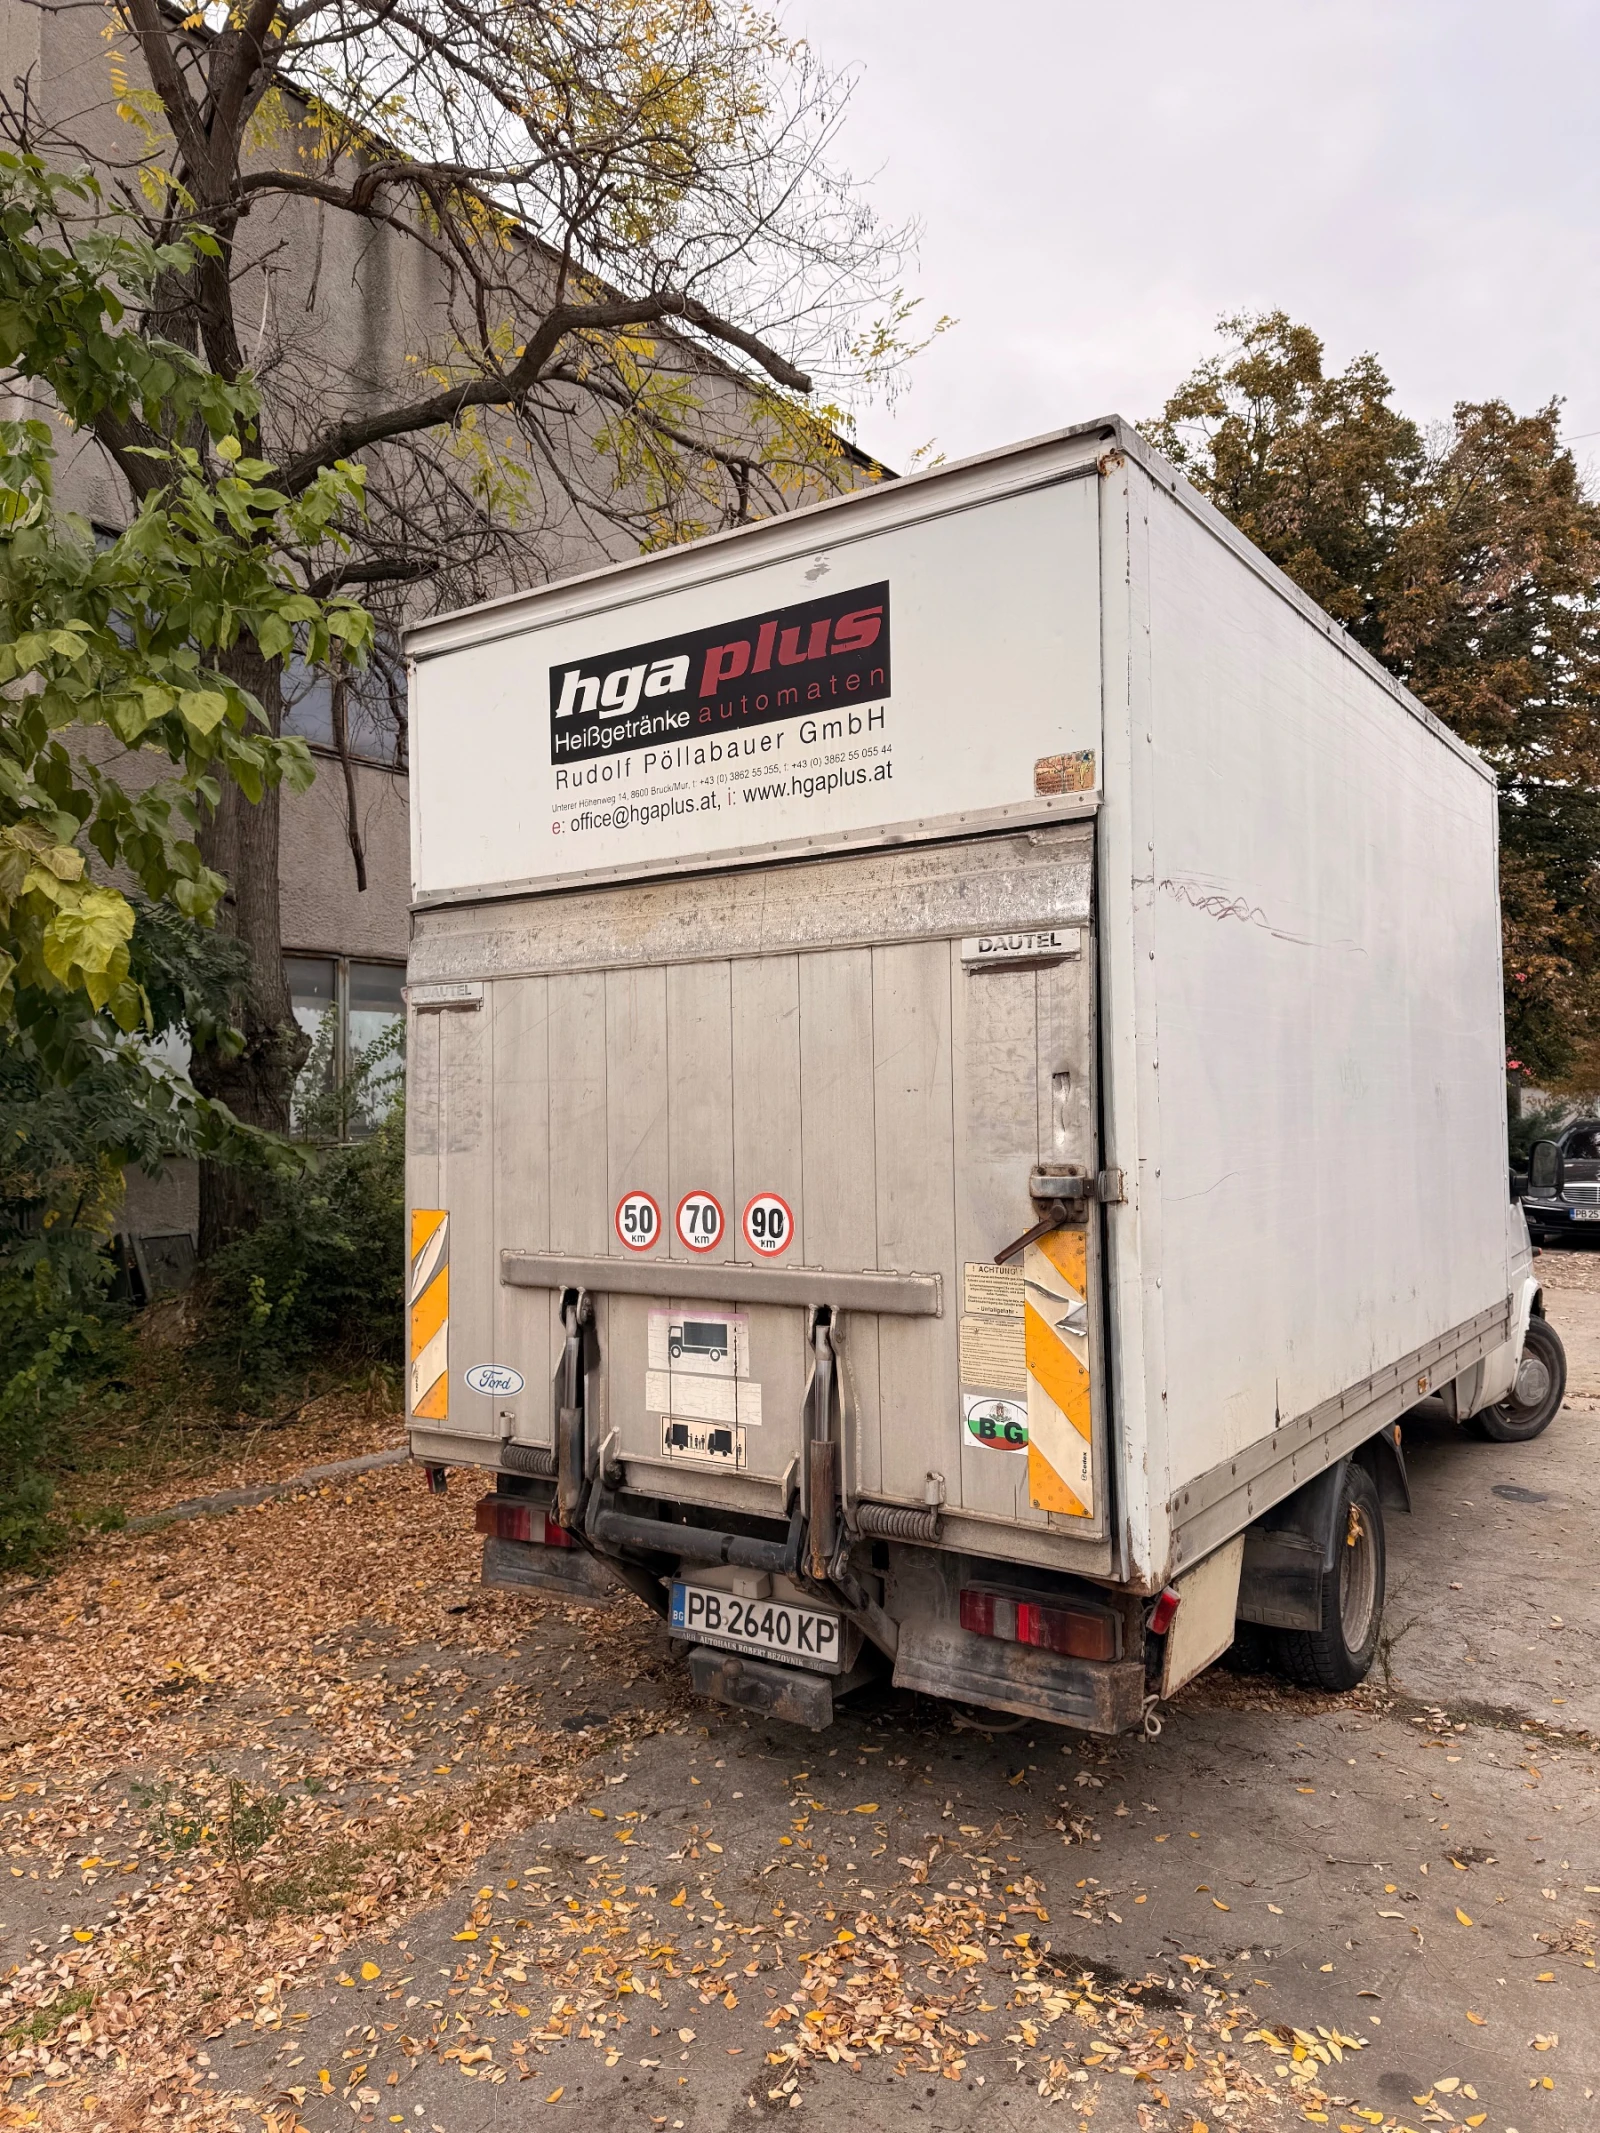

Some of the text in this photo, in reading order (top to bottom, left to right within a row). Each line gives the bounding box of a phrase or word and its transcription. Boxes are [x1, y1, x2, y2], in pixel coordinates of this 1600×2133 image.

[555, 605, 883, 719] hga plus
[555, 667, 884, 753] Heißgetränke automaten
[556, 706, 885, 790] Rudolf Pöllabauer GmbH
[630, 788, 649, 799] 8600
[699, 776, 715, 786] +43
[716, 772, 728, 784] (0)
[729, 769, 749, 781] 3862
[751, 767, 762, 777] 55
[791, 760, 807, 770] +43
[810, 757, 822, 768] (0)
[824, 753, 846, 766] 3862
[848, 749, 859, 760] 55
[861, 746, 878, 758] 055
[881, 744, 892, 754] 44
[551, 760, 893, 834] e: office@hgaplus.at, i: www.hgaplus.at
[978, 932, 1062, 953] DAUTEL
[624, 1204, 653, 1234] 50
[685, 1204, 717, 1235] 70
[752, 1207, 784, 1239] 90
[1588, 1210, 1600, 1219] 25
[478, 1369, 512, 1390] Ford
[673, 1610, 684, 1621] BG
[688, 1592, 835, 1654] PB 2640 KP
[700, 1635, 737, 1651] AUTOHAUS
[738, 1644, 766, 1658] ROBERT
